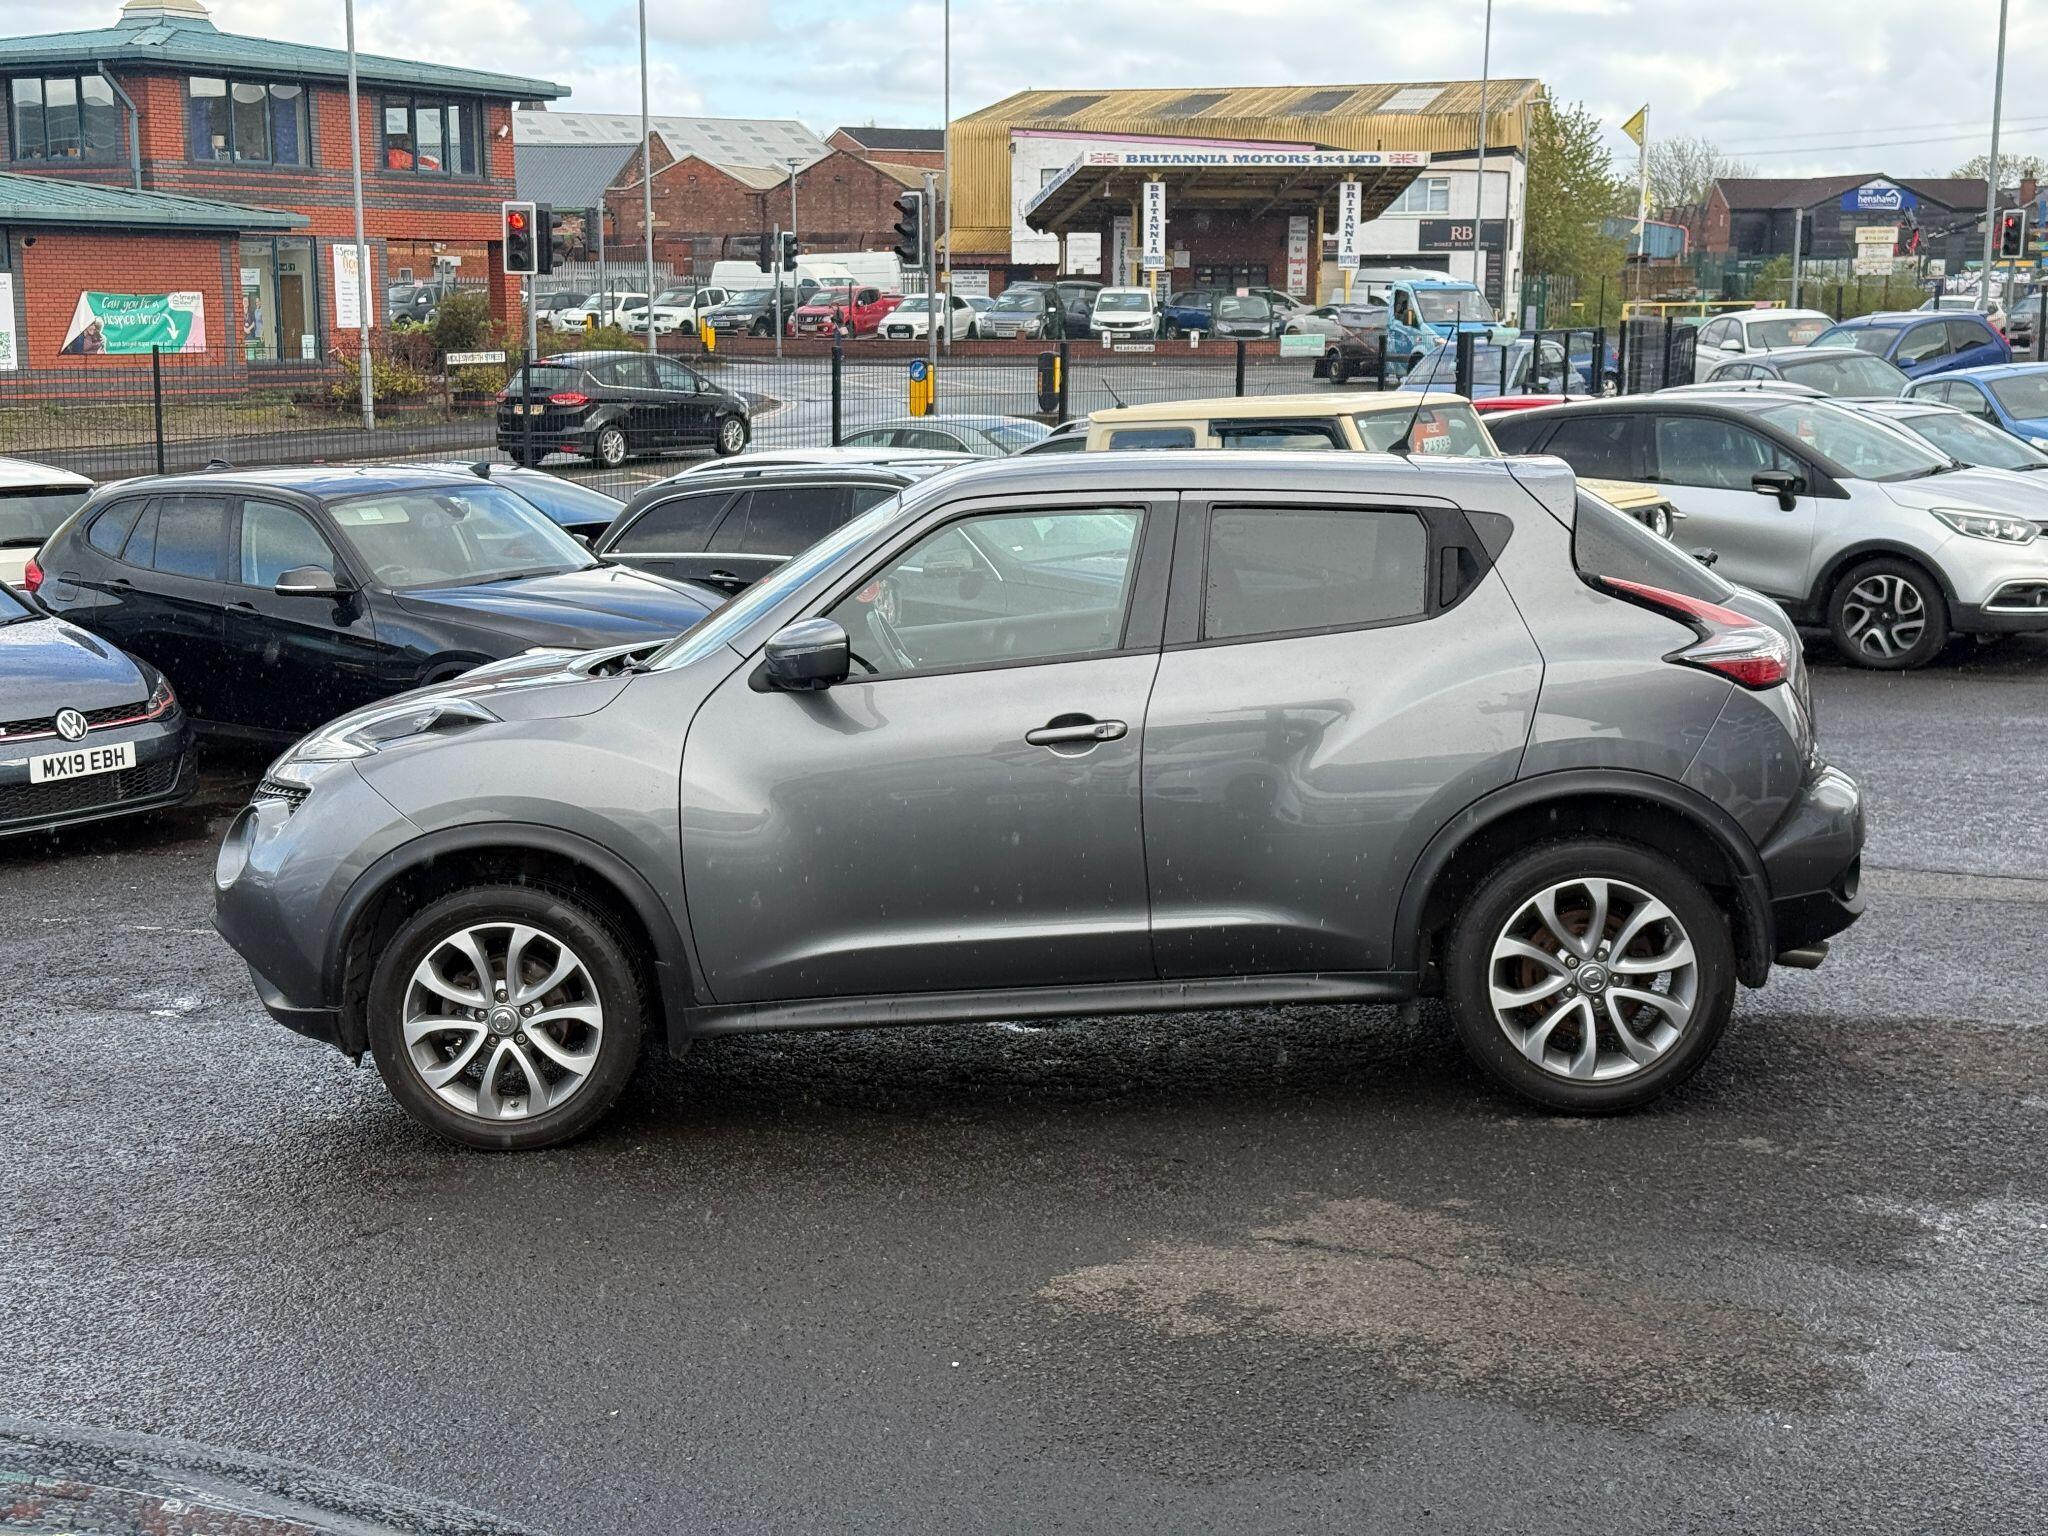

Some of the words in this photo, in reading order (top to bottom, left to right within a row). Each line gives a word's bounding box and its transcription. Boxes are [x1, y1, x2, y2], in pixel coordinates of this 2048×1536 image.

[1126, 154, 1227, 164] BRITANNIA
[1233, 154, 1310, 164] MOTORS
[1313, 154, 1345, 164] 4x4
[1349, 155, 1381, 164] LTD
[1150, 185, 1159, 254] BRITANNIA
[1345, 184, 1356, 253] BRITANNIA
[1450, 226, 1473, 240] RB
[101, 297, 119, 308] Can
[121, 301, 139, 314] you
[103, 312, 136, 329] Hospice
[43, 754, 85, 778] MX19
[90, 747, 125, 771] EBH
